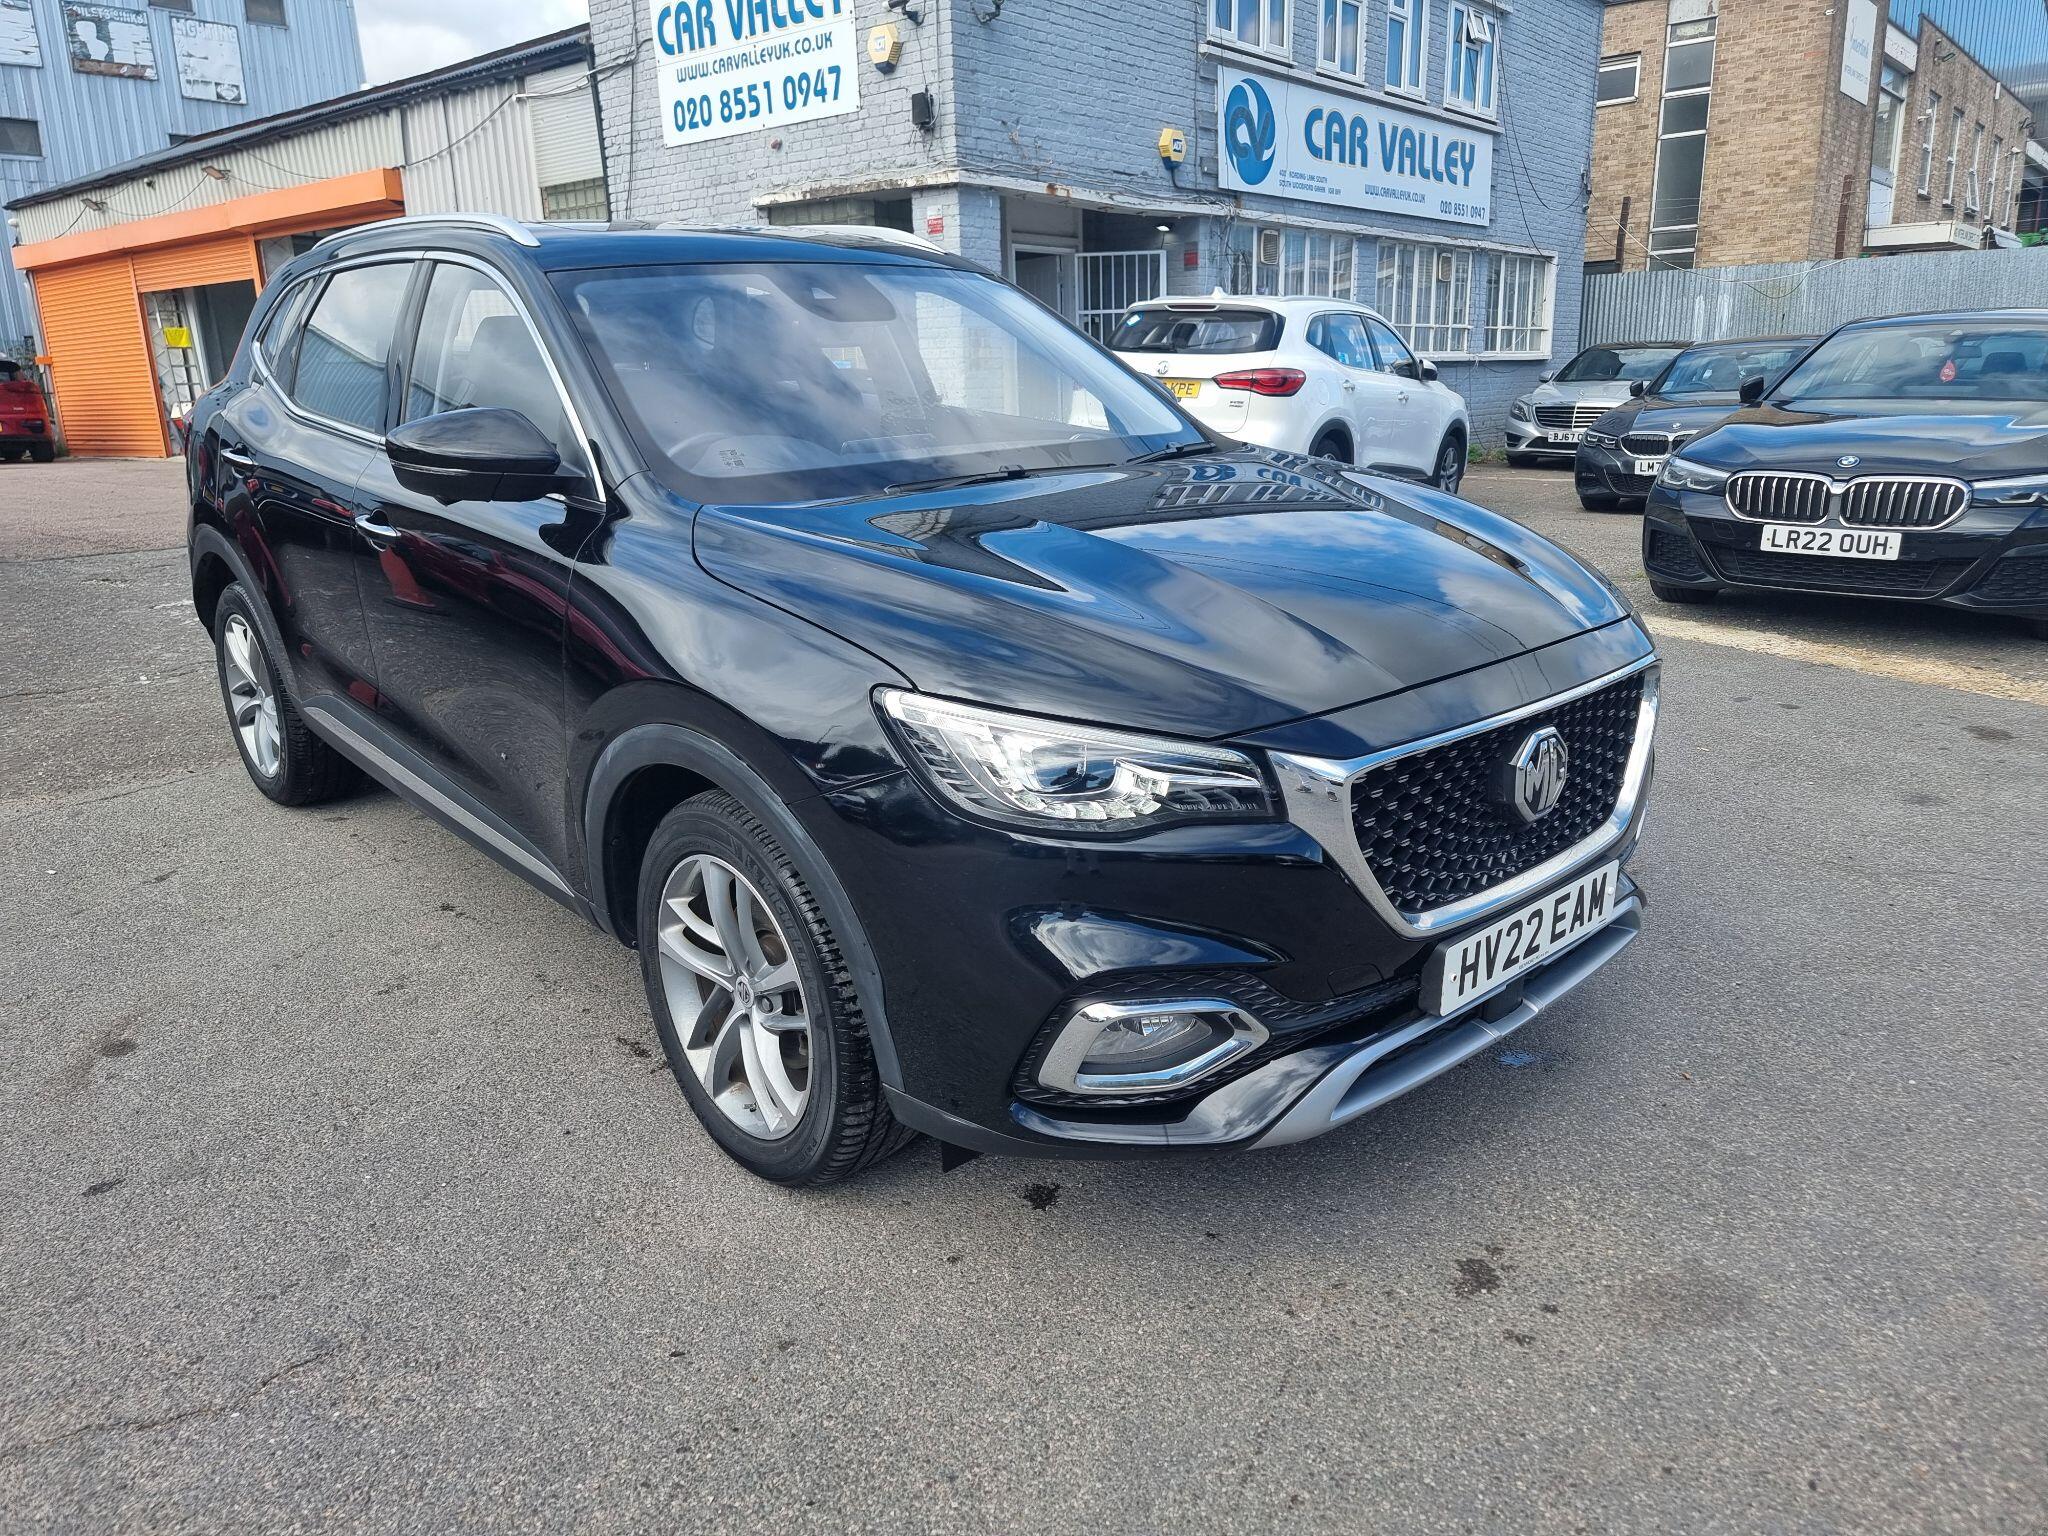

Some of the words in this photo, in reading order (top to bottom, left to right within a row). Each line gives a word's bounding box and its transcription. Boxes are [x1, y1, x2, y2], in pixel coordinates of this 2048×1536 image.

[658, 0, 716, 55] CAR
[676, 32, 833, 83] WWW.CARVALLEYUK.CO.UK
[673, 94, 712, 132] 020
[719, 80, 773, 123] 8551
[782, 65, 841, 110] 0947
[1304, 107, 1368, 168] CAR
[1378, 120, 1476, 187] VALLEY
[1439, 200, 1452, 215] 020
[1453, 202, 1469, 218] 8551
[1470, 205, 1486, 220] 0947
[1170, 383, 1195, 395] KPE
[1553, 433, 1576, 441] BJ67
[1770, 528, 1833, 551] LR22
[1838, 533, 1889, 556] OUH
[1521, 732, 1567, 816] MG
[1458, 907, 1544, 997] HV22
[1550, 872, 1608, 945] EAM
